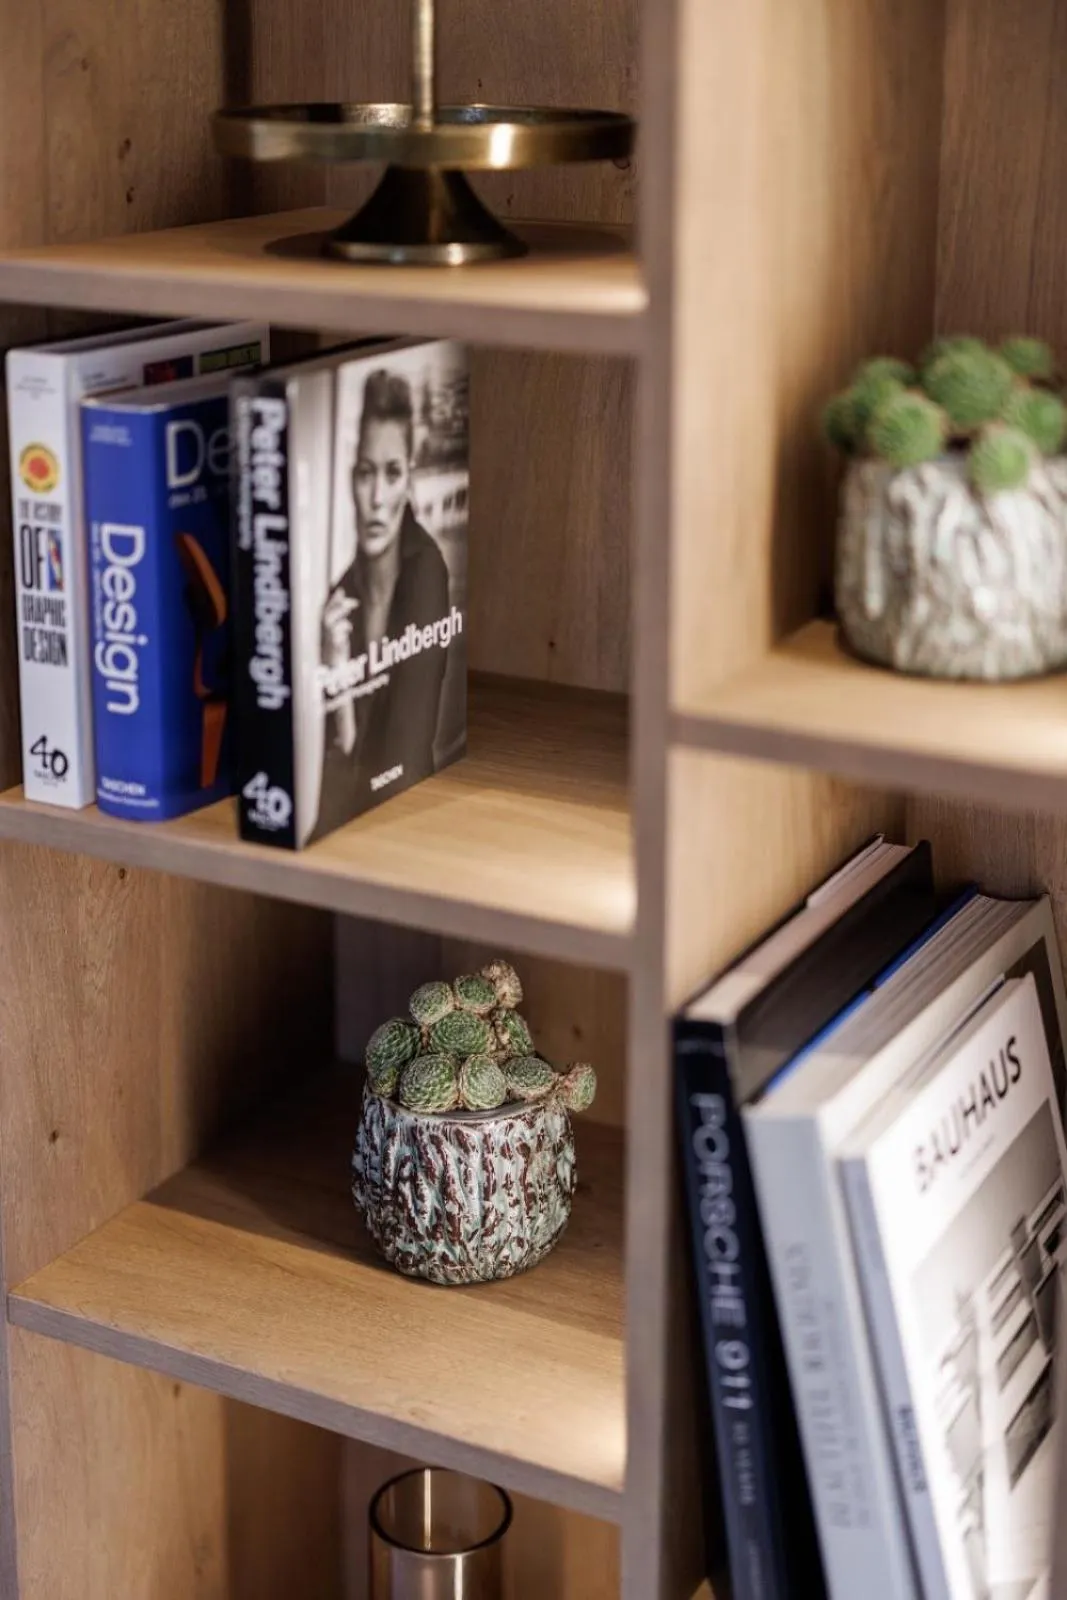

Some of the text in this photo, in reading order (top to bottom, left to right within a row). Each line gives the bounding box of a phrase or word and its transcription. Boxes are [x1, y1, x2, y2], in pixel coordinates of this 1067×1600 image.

[20, 524, 44, 591] OF
[249, 397, 290, 710] Peter Lindbergh
[22, 594, 66, 628] GRAPHIC
[94, 523, 149, 716] Design
[368, 605, 463, 675] Lindbergh
[23, 626, 68, 668] DESIGN
[29, 735, 69, 777] 40
[690, 1092, 747, 1328] PORSCHE
[714, 1339, 753, 1410] 911
